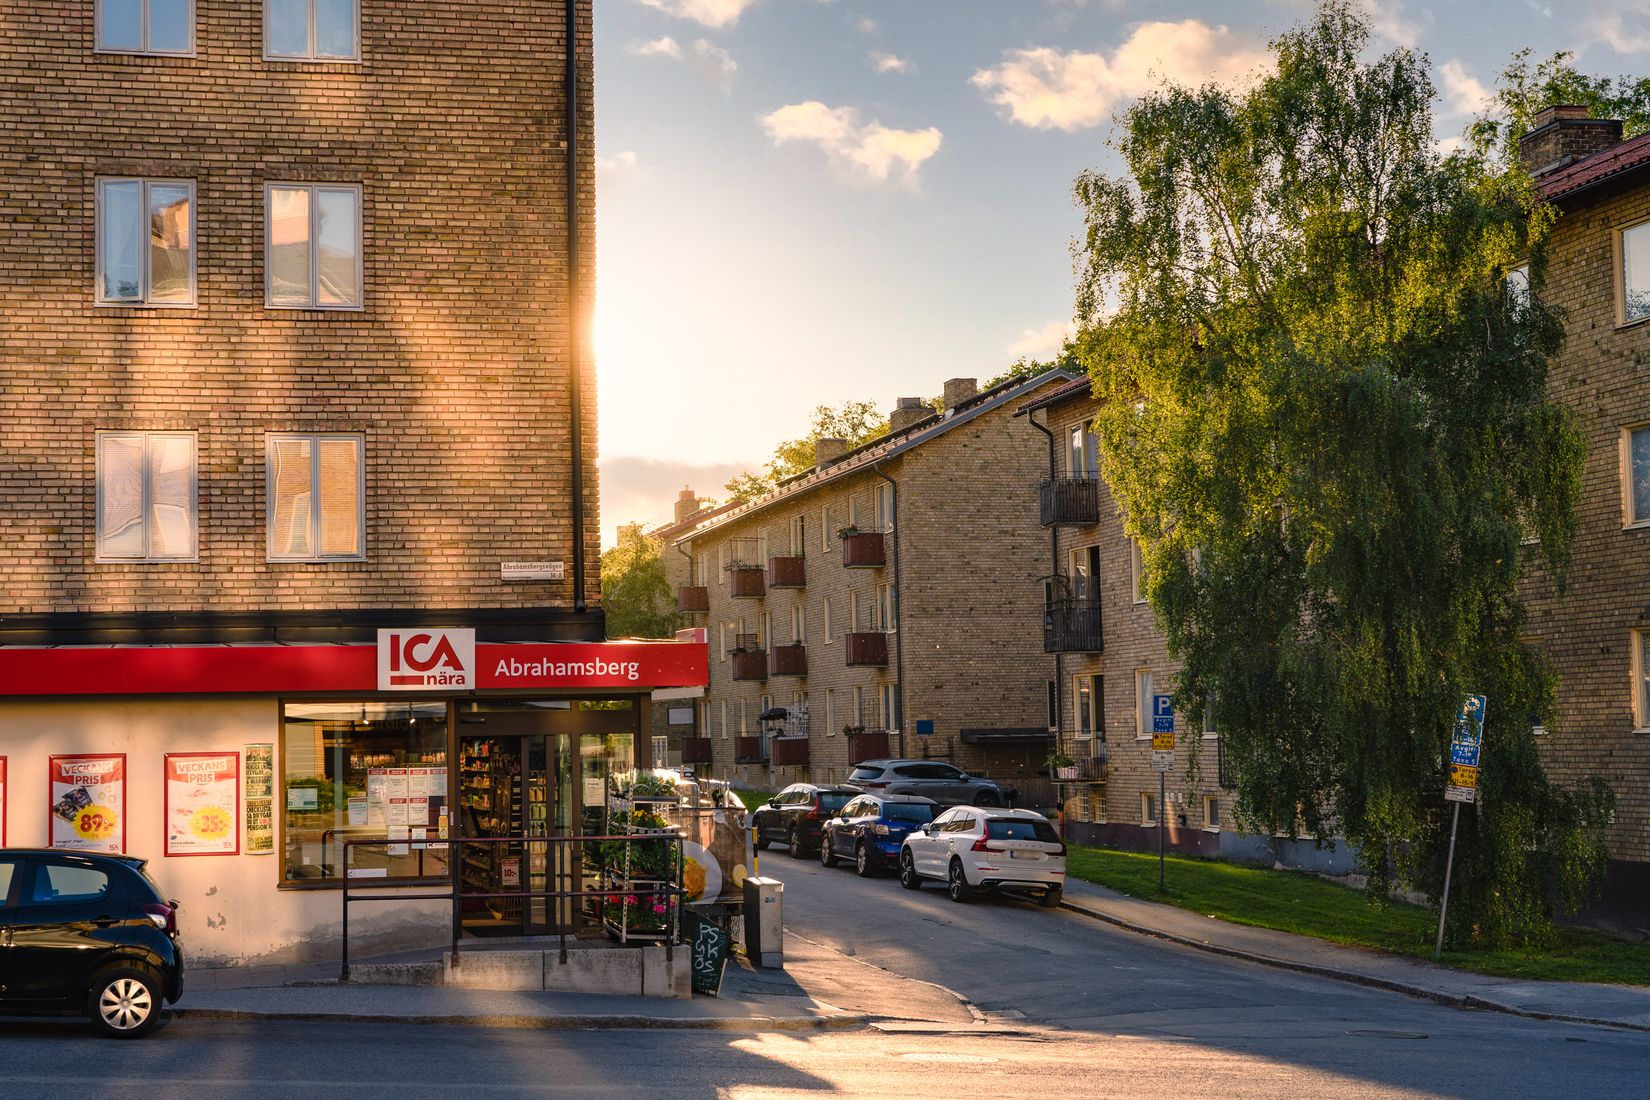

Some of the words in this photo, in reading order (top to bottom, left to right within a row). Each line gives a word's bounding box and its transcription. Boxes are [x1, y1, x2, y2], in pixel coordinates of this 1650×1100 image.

[502, 562, 562, 570] Abrahamsbergsvägen
[390, 634, 465, 672] ICA
[495, 657, 640, 681] Abrahamsberg
[426, 672, 466, 686] nära
[1158, 697, 1170, 714] P
[1463, 698, 1480, 718] P
[1456, 746, 1476, 754] Avgift
[64, 762, 112, 774] VECKANS
[178, 760, 225, 773] VECKANS
[1458, 767, 1476, 775] Torsd
[76, 776, 100, 784] PRIS
[190, 774, 213, 783] PRIS
[80, 813, 115, 833] 89:-
[504, 868, 516, 877] 10:-
